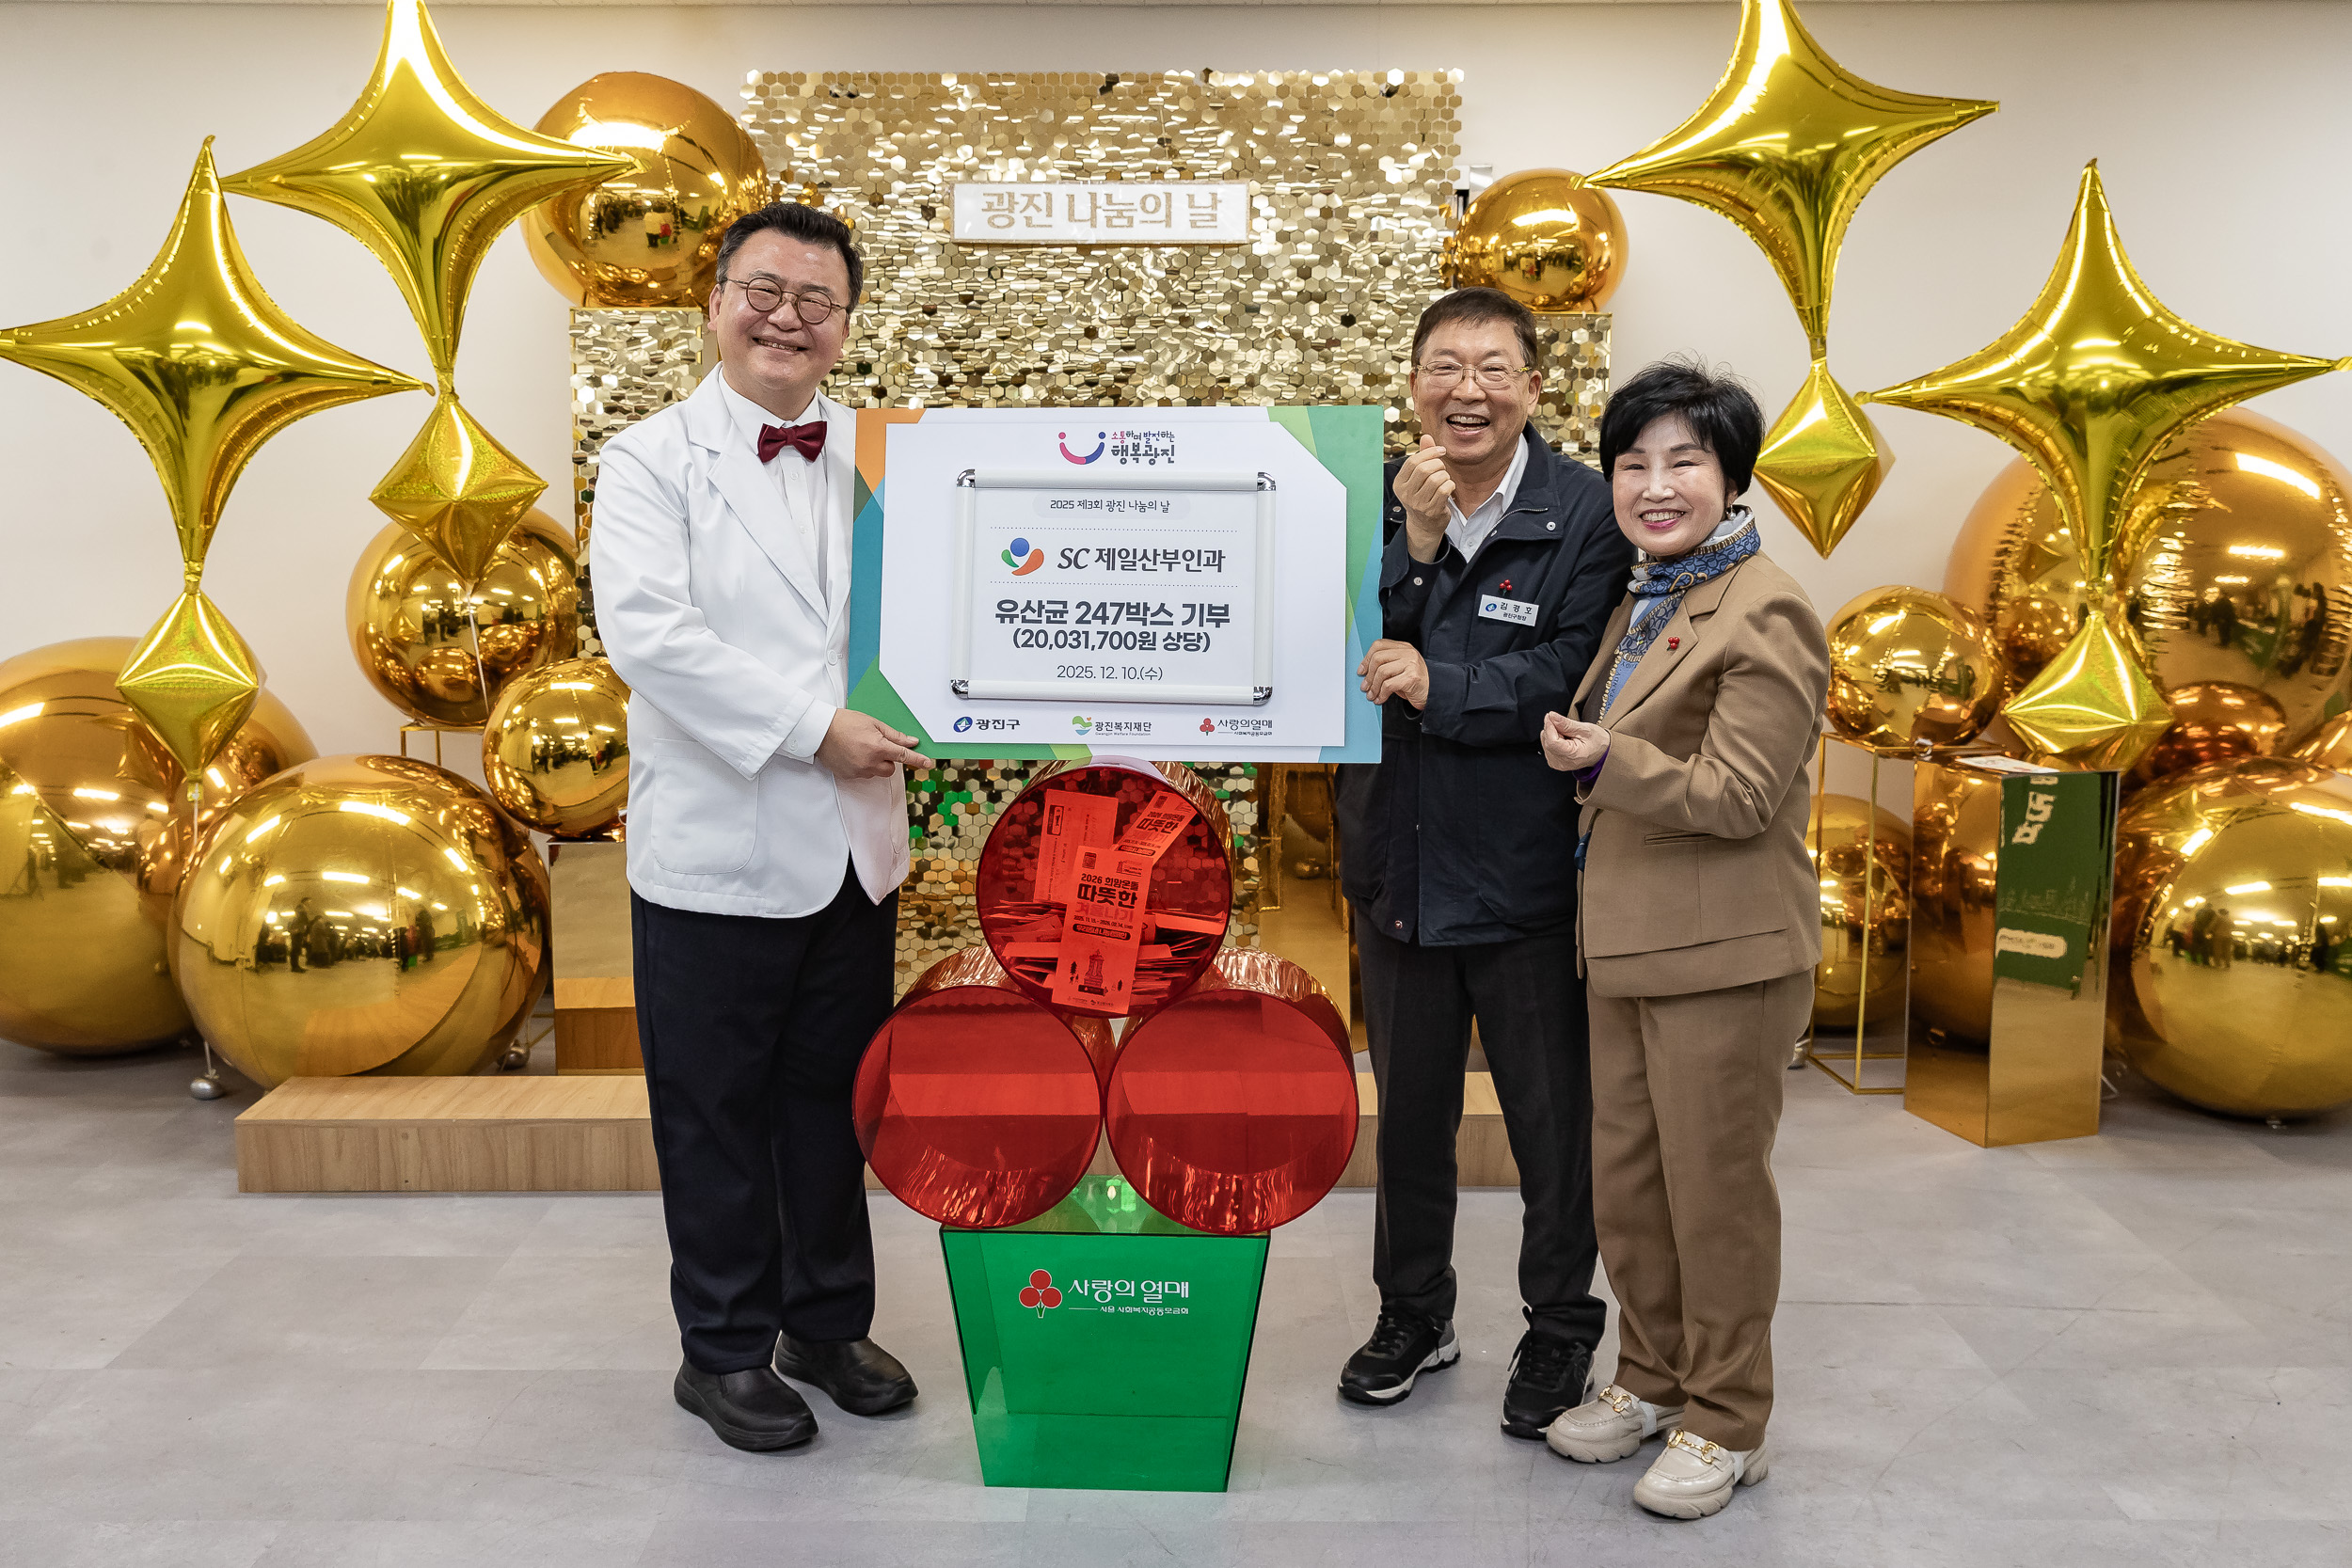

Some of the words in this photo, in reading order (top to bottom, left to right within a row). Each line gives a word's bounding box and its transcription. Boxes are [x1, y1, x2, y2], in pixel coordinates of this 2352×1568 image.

[981, 191, 1054, 230] 광진
[1065, 191, 1172, 230] 나눔의
[1185, 191, 1223, 230] 날
[1111, 430, 1142, 444] 소통하며
[1143, 430, 1176, 444] 발전하는
[1111, 442, 1175, 466] 행복광진
[1050, 499, 1074, 510] 2025
[1076, 499, 1103, 510] 제3회
[1105, 499, 1125, 513] 광진
[1128, 499, 1157, 514] 나눔의
[1160, 500, 1170, 514] 날
[1057, 547, 1091, 570] SC
[1094, 547, 1227, 573] 제일산부인과
[994, 598, 1070, 625] 유산균
[1074, 600, 1174, 626] 247박스
[1181, 602, 1231, 628] 기부
[1012, 627, 1157, 651] (20,031,700원
[1162, 631, 1211, 653] 상당)
[1057, 664, 1096, 679] 2025.
[1100, 666, 1118, 680] 12.
[1120, 666, 1163, 681] 10.(수)
[975, 719, 1021, 731] 광진구
[1094, 721, 1152, 732] 광진복지재단
[1217, 719, 1273, 731] 사랑의열매
[1136, 817, 1180, 834] 따뜻한
[1081, 873, 1103, 884] 2026
[1104, 877, 1139, 891] 희망온돌
[1076, 882, 1138, 909] 따뜻한
[1068, 1279, 1136, 1304] 사랑의
[1140, 1280, 1189, 1304] 열매
